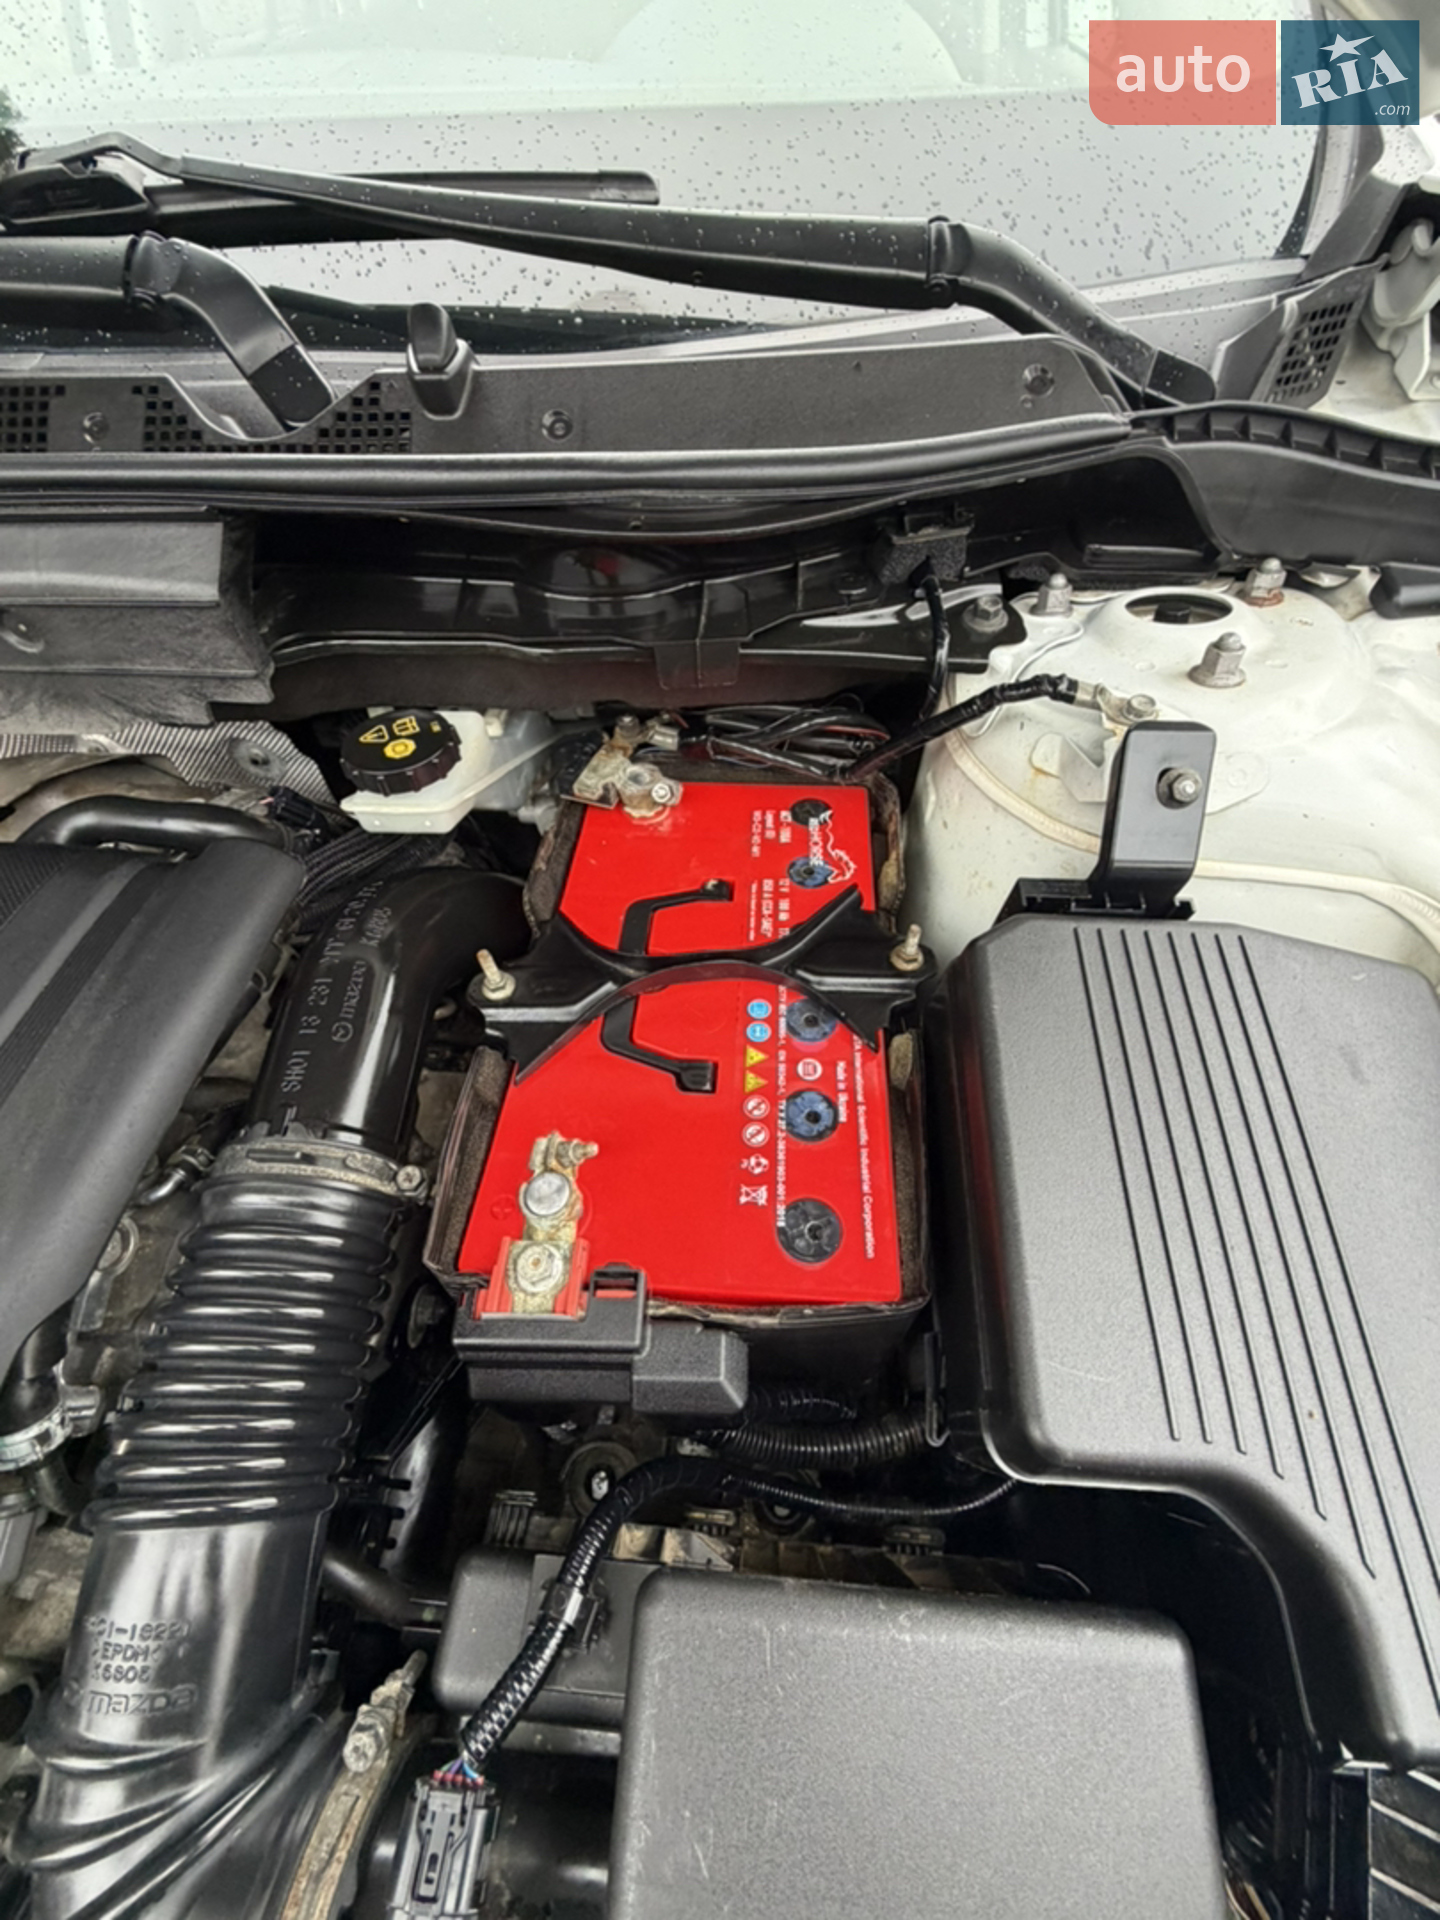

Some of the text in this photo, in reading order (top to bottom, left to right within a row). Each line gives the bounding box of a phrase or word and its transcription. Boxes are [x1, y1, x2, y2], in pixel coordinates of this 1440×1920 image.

[854, 1051, 866, 1102] International
[838, 1092, 849, 1123] Ukraine
[857, 1105, 869, 1146] Scientific
[859, 1148, 873, 1193] Industrial
[862, 1195, 876, 1260] Corporation
